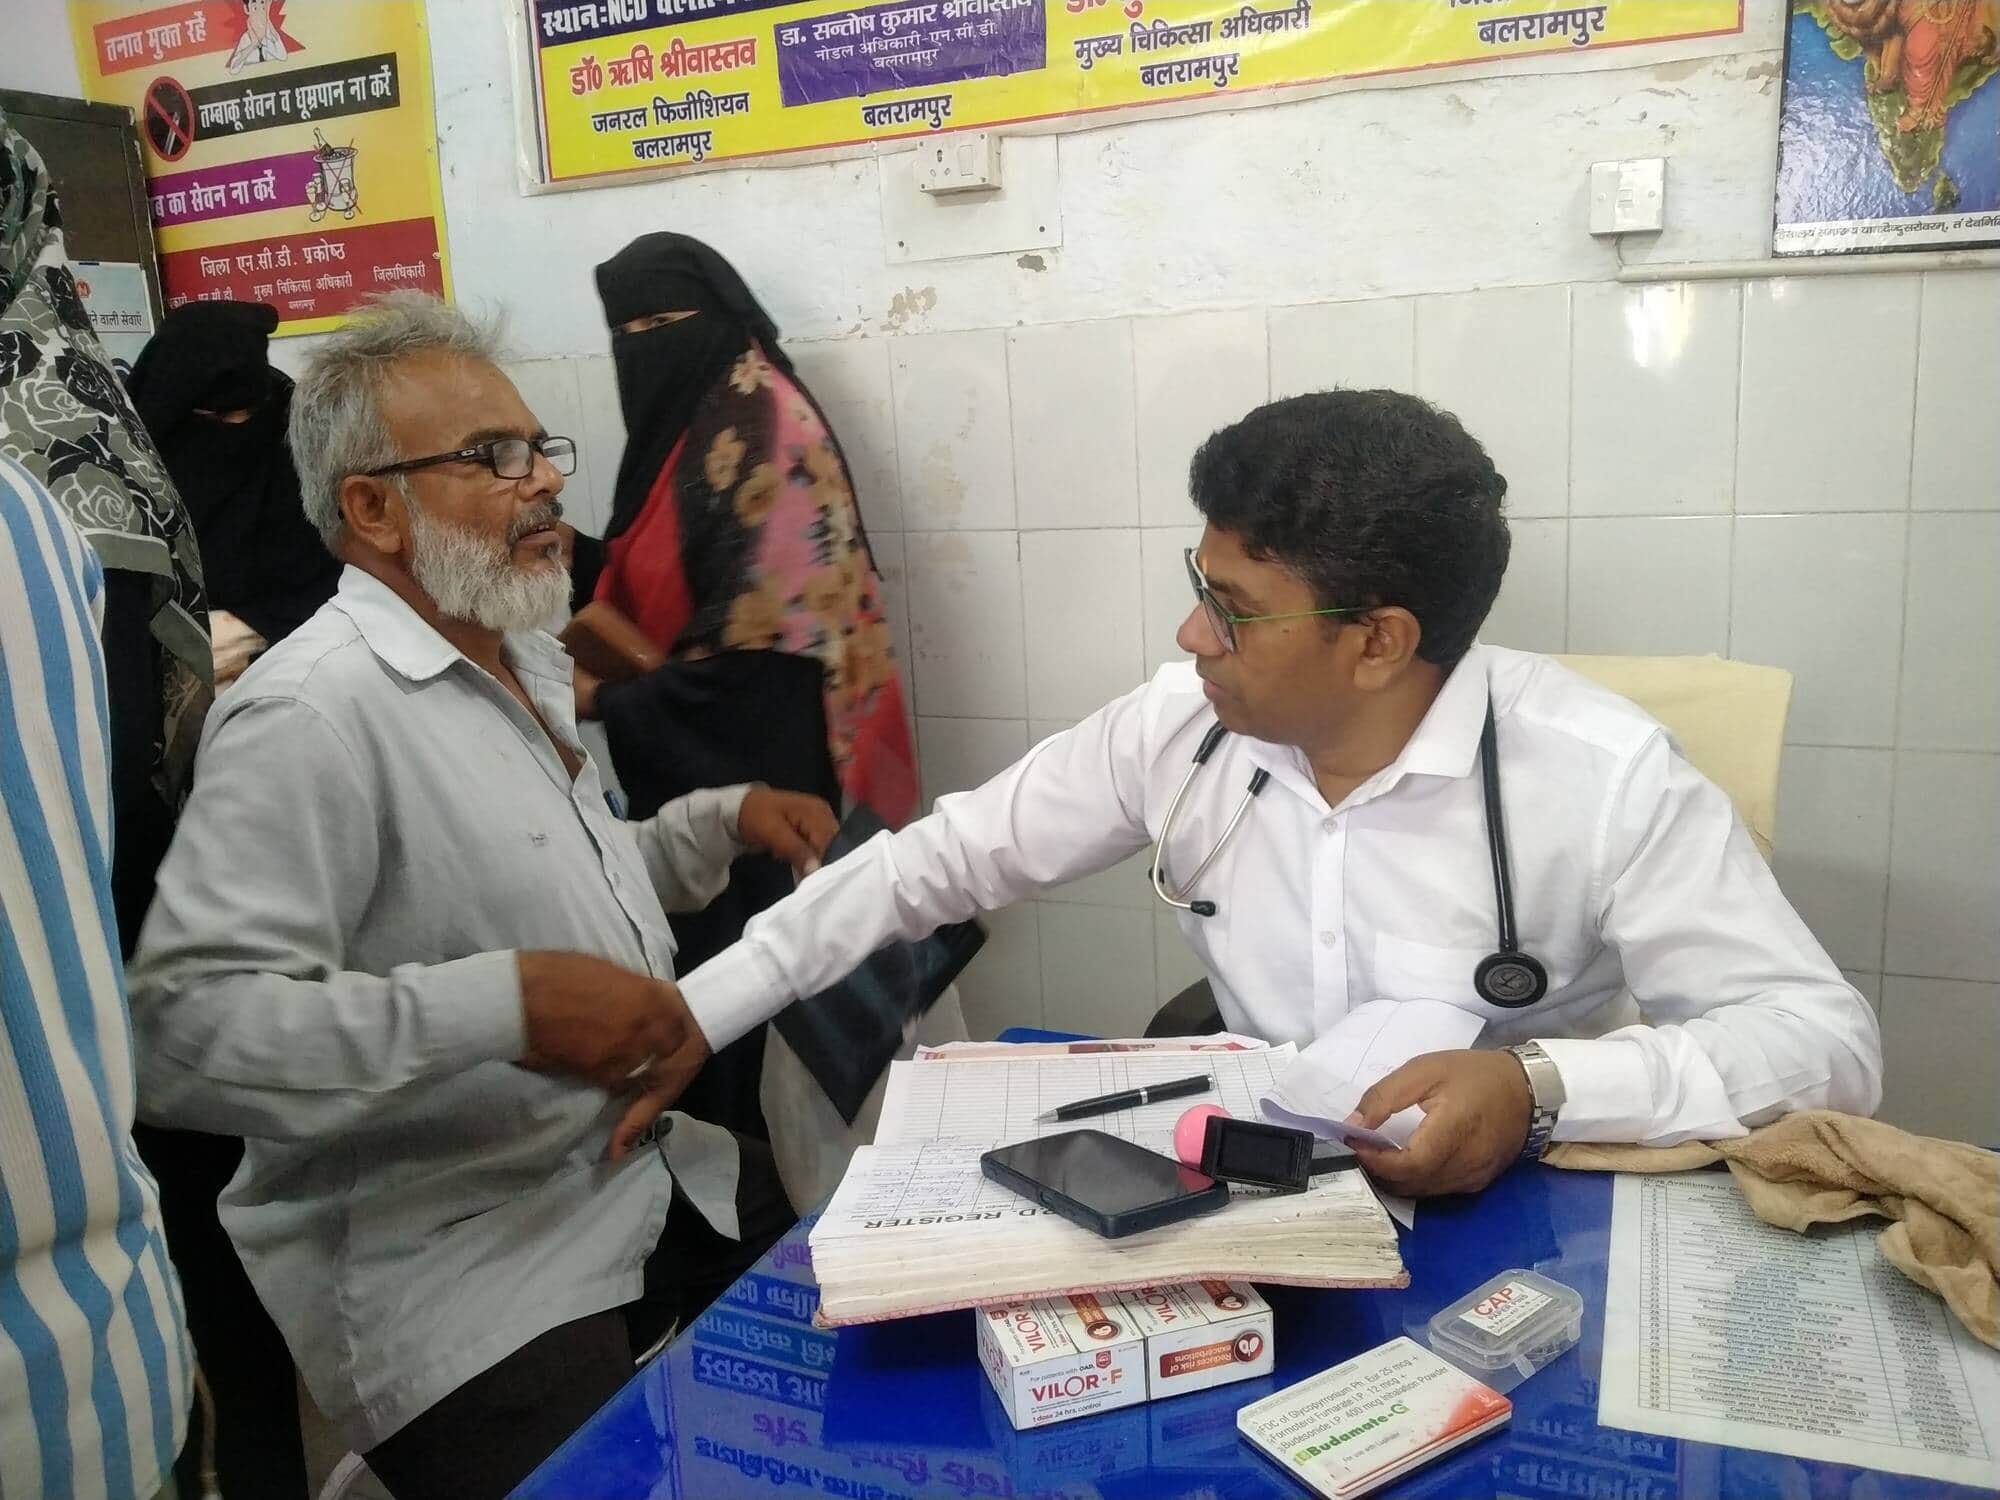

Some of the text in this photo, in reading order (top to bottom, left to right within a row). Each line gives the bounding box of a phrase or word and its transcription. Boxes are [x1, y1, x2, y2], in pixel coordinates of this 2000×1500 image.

[104, 11, 207, 62] तनाव मुक्त रहें
[812, 12, 876, 39] सन्तोष
[880, 5, 938, 36] कुमार
[1074, 0, 1311, 69] मुख्य चिकित्सा अधिकारी
[1477, 6, 1608, 46] बलरामपुर
[608, 45, 655, 87] ऋषि
[660, 38, 757, 79] श्रीवास्तव
[814, 43, 854, 62] नोडल
[872, 48, 939, 71] बलरामपुर
[1140, 53, 1240, 87] बलरामपुर
[198, 64, 392, 131] तम्बाकू सेवन व धूम्रपान ना करें
[592, 90, 750, 133] जनरल फिजीशियन
[861, 95, 953, 129] बलरामपुर
[632, 130, 712, 162] बलरामपुर
[166, 191, 187, 216] का
[190, 181, 226, 212] सेवन
[229, 180, 249, 205] ना
[251, 168, 277, 202] करें
[199, 255, 231, 278] जिला
[302, 238, 346, 265] प्रकोष्ठ
[373, 260, 426, 283] जिलाधिकारी
[277, 277, 312, 296] चिकित्सा
[316, 272, 353, 292] अधिकारी
[864, 1211, 1001, 1229] REGISTER
[1473, 1286, 1514, 1316] CAP
[1169, 1352, 1232, 1374] Reduces risk of
[1174, 1344, 1232, 1363] exacerbations
[1077, 1401, 1102, 1415] control
[1258, 1418, 1280, 1433] FDC
[1280, 1413, 1290, 1424] of
[1379, 1367, 1393, 1376] 25
[1392, 1360, 1413, 1371] mcg
[1271, 1415, 1314, 1441] Formoterol
[1367, 1384, 1381, 1394] 12
[1380, 1376, 1401, 1389] mcg
[1280, 1423, 1332, 1449] Budesonide
[1345, 1406, 1364, 1418] 400
[1363, 1398, 1384, 1411] mcg
[1306, 1402, 1410, 1457] Budamate-G
